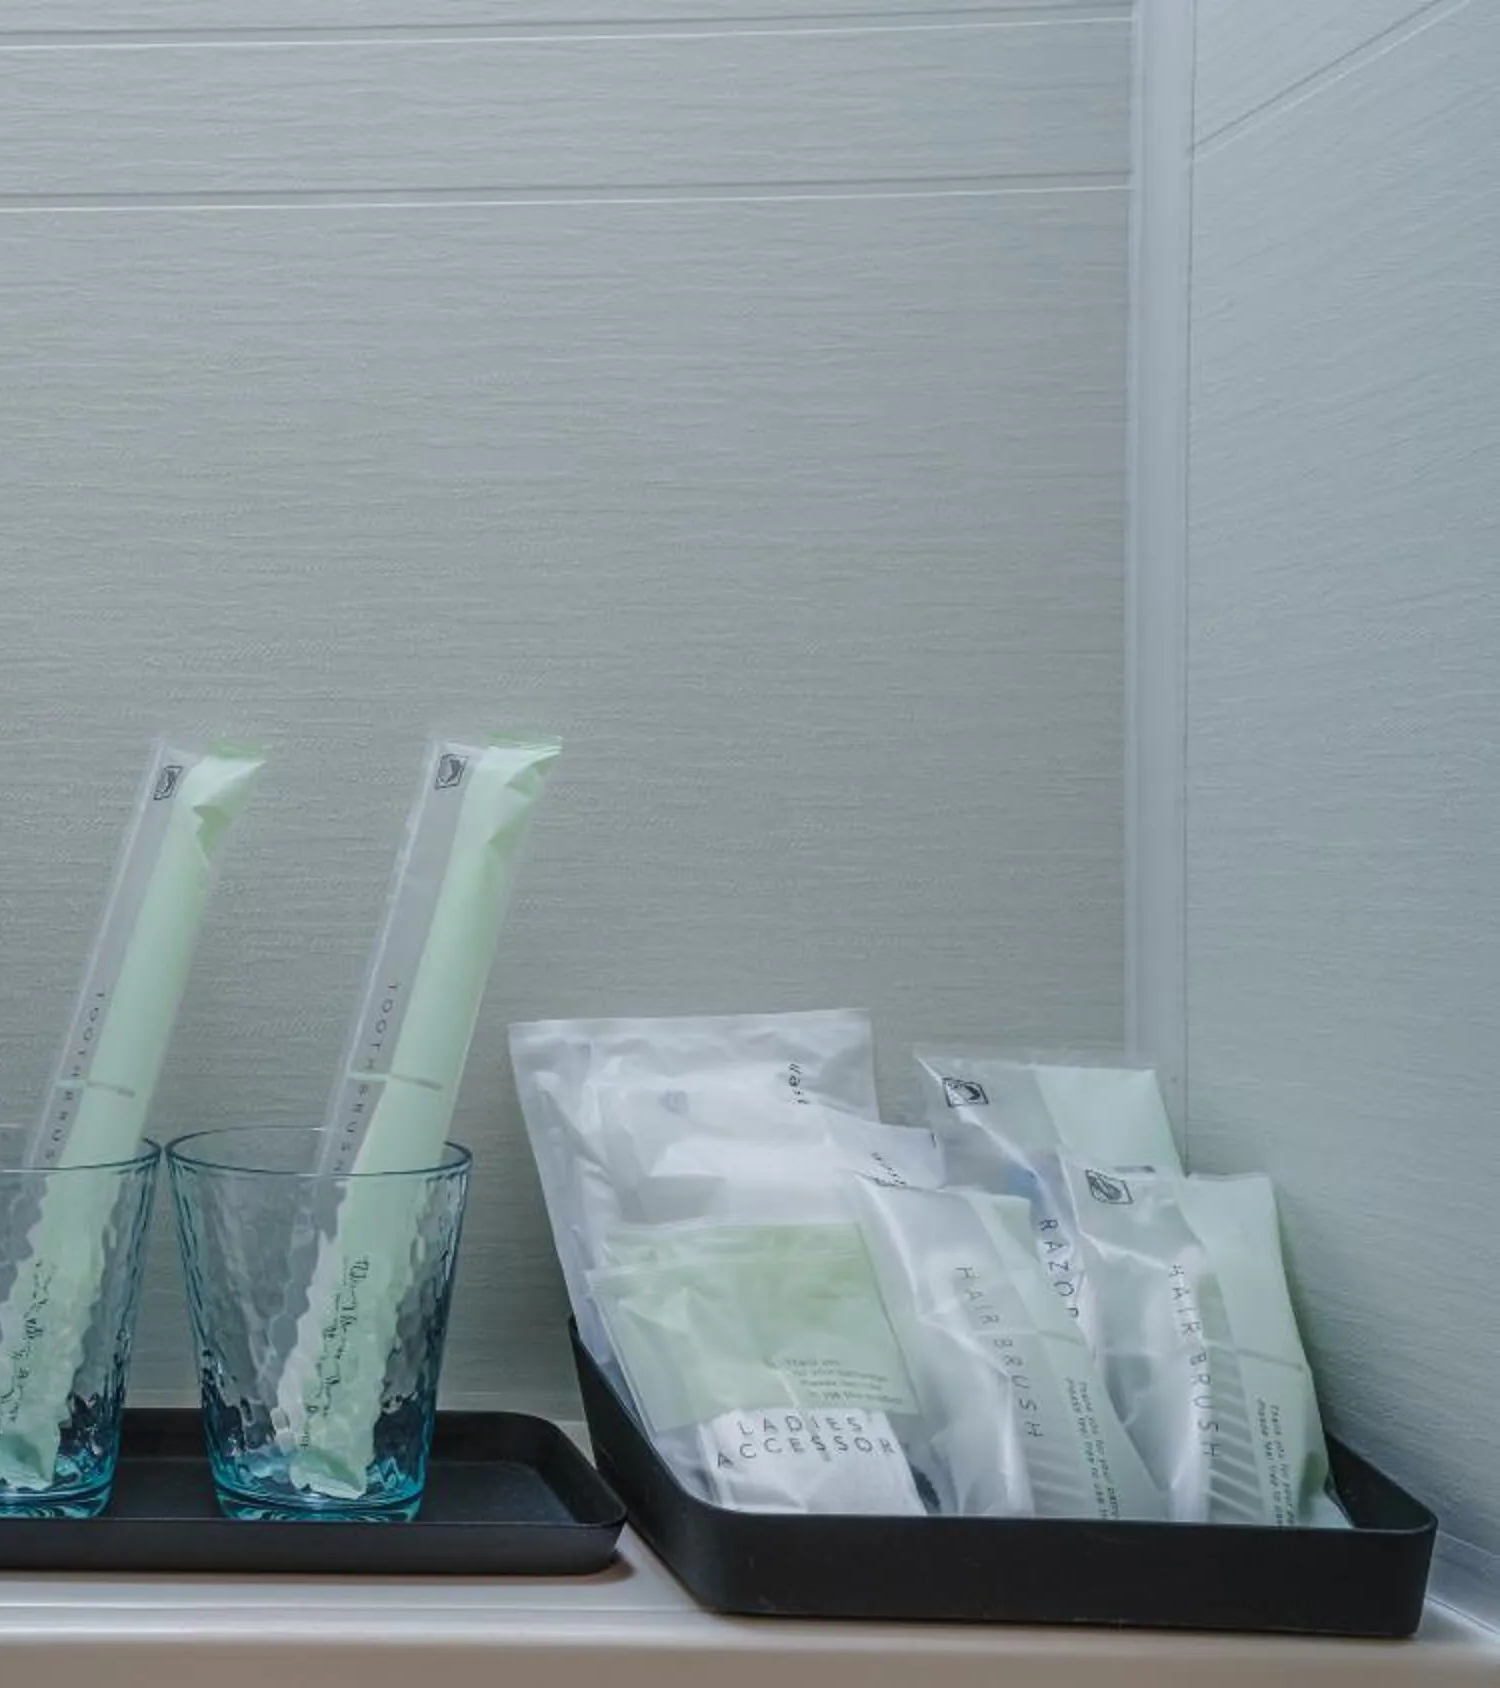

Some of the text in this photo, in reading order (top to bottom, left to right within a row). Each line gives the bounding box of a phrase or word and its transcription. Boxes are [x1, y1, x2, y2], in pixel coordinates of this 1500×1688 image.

[737, 1413, 867, 1436] LADIES
[955, 1265, 1045, 1438] HAIR BRUSH
[1167, 1264, 1221, 1458] HAIR BRUSH
